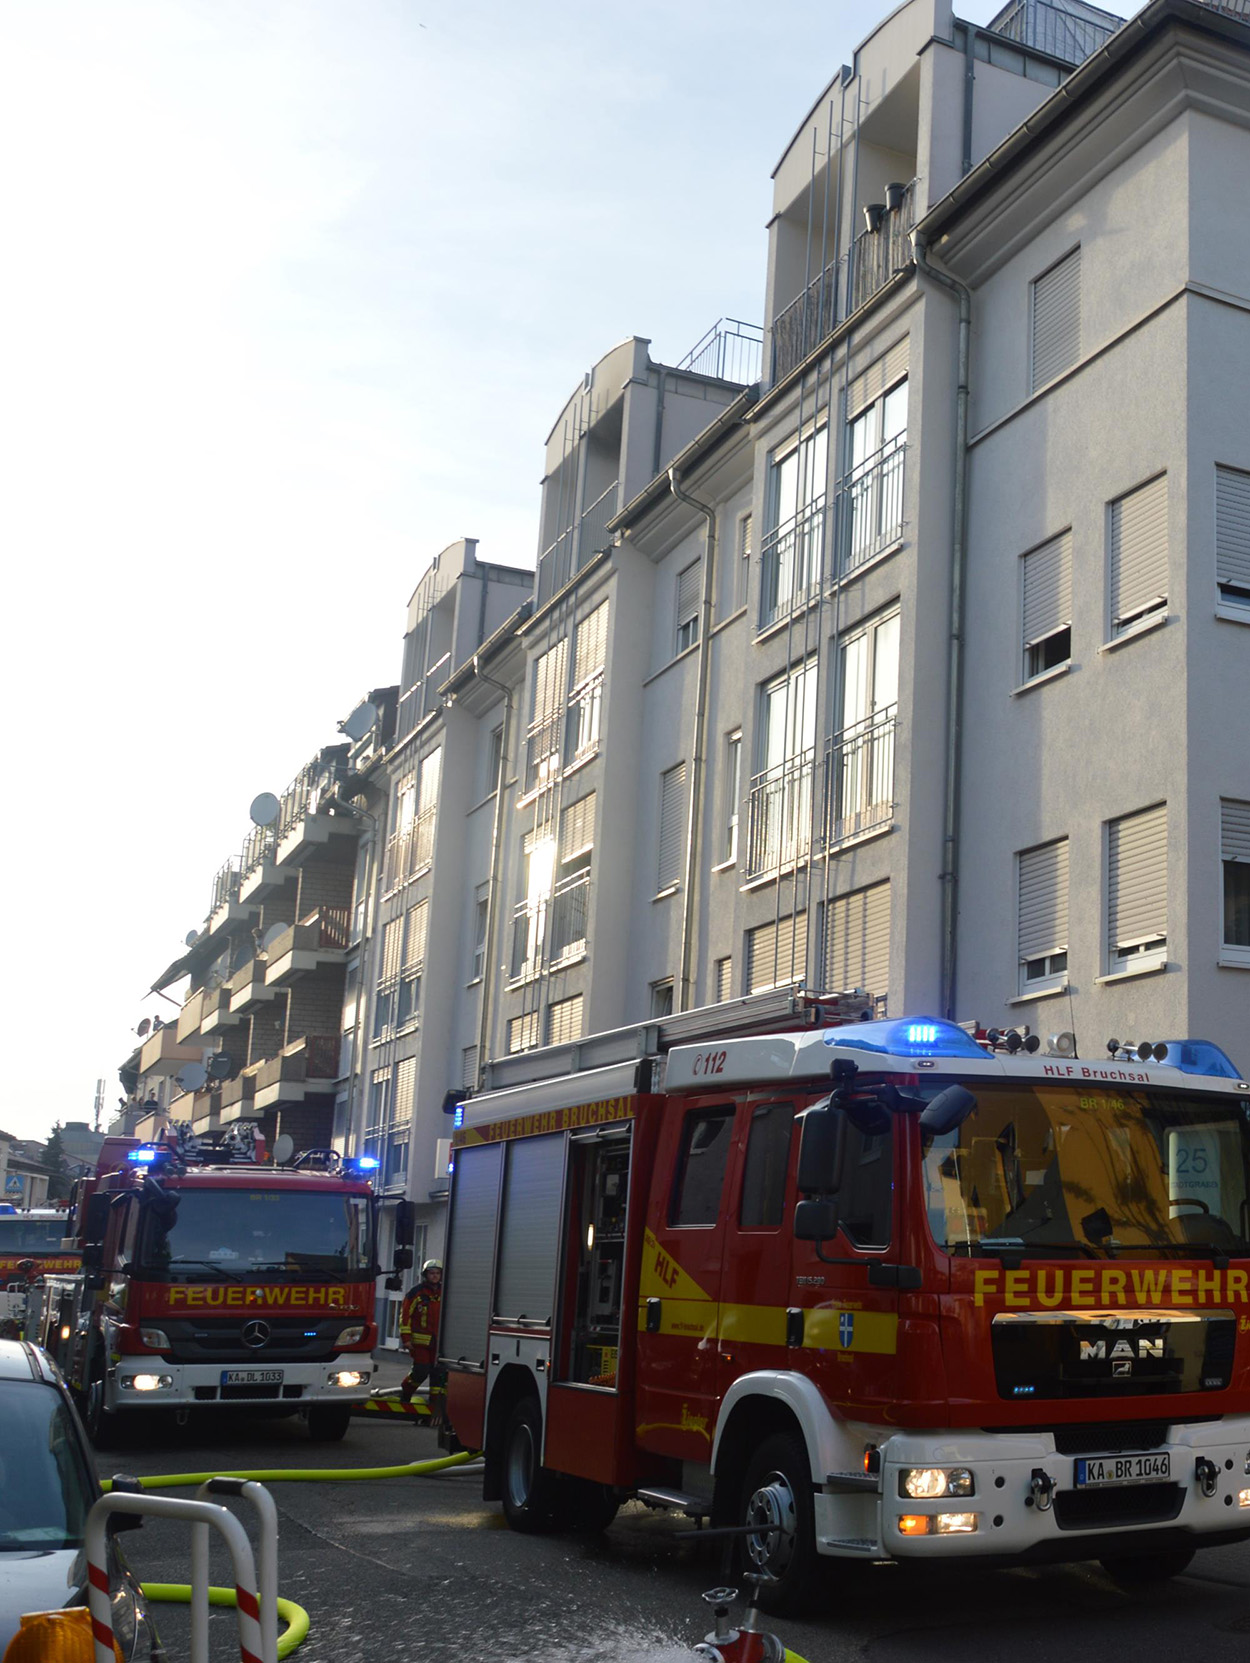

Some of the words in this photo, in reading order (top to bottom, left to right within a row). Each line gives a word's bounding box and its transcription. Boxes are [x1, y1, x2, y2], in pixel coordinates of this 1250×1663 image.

[703, 1050, 727, 1075] 112
[1043, 1065, 1074, 1077] HLF
[1081, 1067, 1150, 1083] Bruchsal
[1080, 1098, 1097, 1109] BR
[1101, 1098, 1125, 1111] 1/46
[488, 1111, 557, 1141] FEUERWEHR
[562, 1096, 635, 1129] BRUCHSAL
[1176, 1147, 1208, 1174] 25
[653, 1250, 680, 1290] HLF
[168, 1286, 346, 1306] FEUERWEHR
[974, 1268, 1249, 1307] FEUERWEHR
[1079, 1338, 1164, 1361] MAN
[228, 1372, 240, 1383] KA
[246, 1372, 258, 1382] DL
[259, 1371, 282, 1382] 1033
[1087, 1462, 1105, 1481] KA
[1115, 1460, 1132, 1478] BR
[1135, 1457, 1168, 1477] 1046
